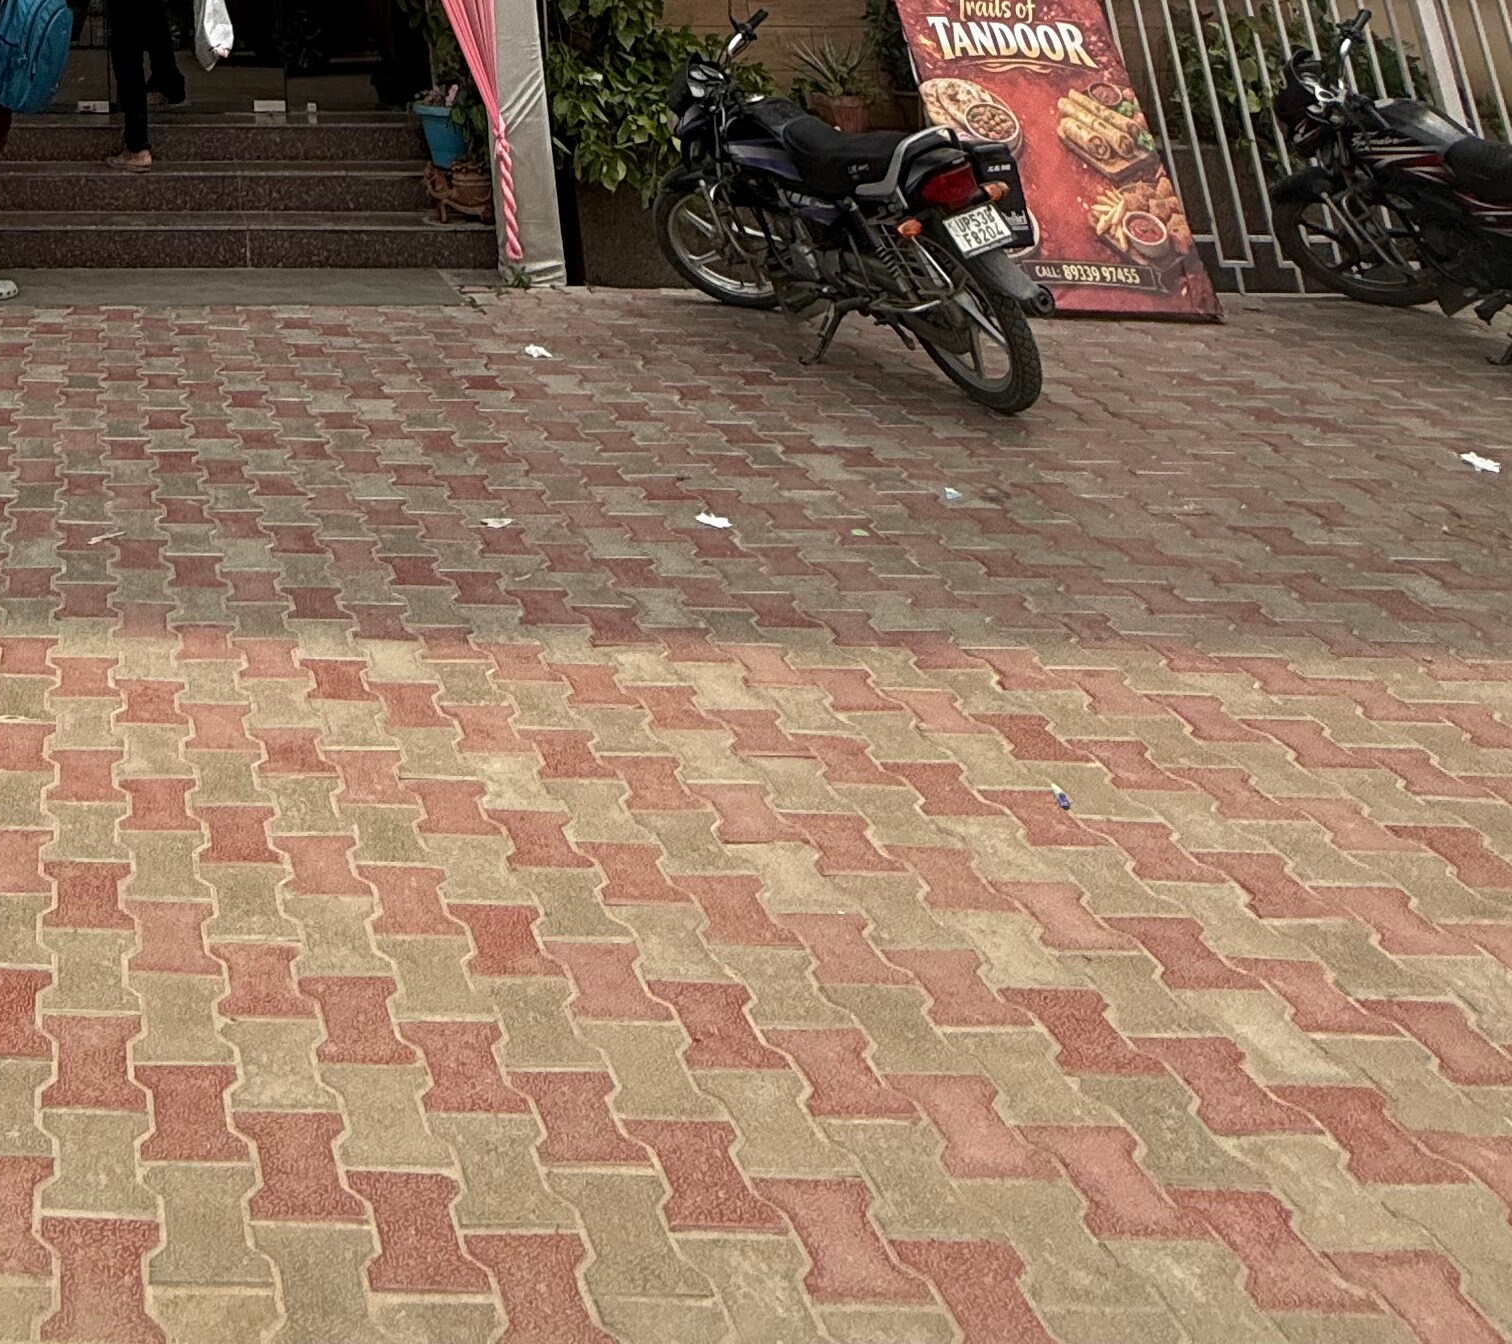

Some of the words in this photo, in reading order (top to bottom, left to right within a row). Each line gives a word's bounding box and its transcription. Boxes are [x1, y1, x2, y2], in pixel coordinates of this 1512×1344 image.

[926, 15, 1099, 69] TANDOOR
[962, 222, 1004, 249] F8204
[1035, 265, 1062, 279] CALL:
[1062, 264, 1101, 281] 89339
[1102, 266, 1141, 284] 97455
